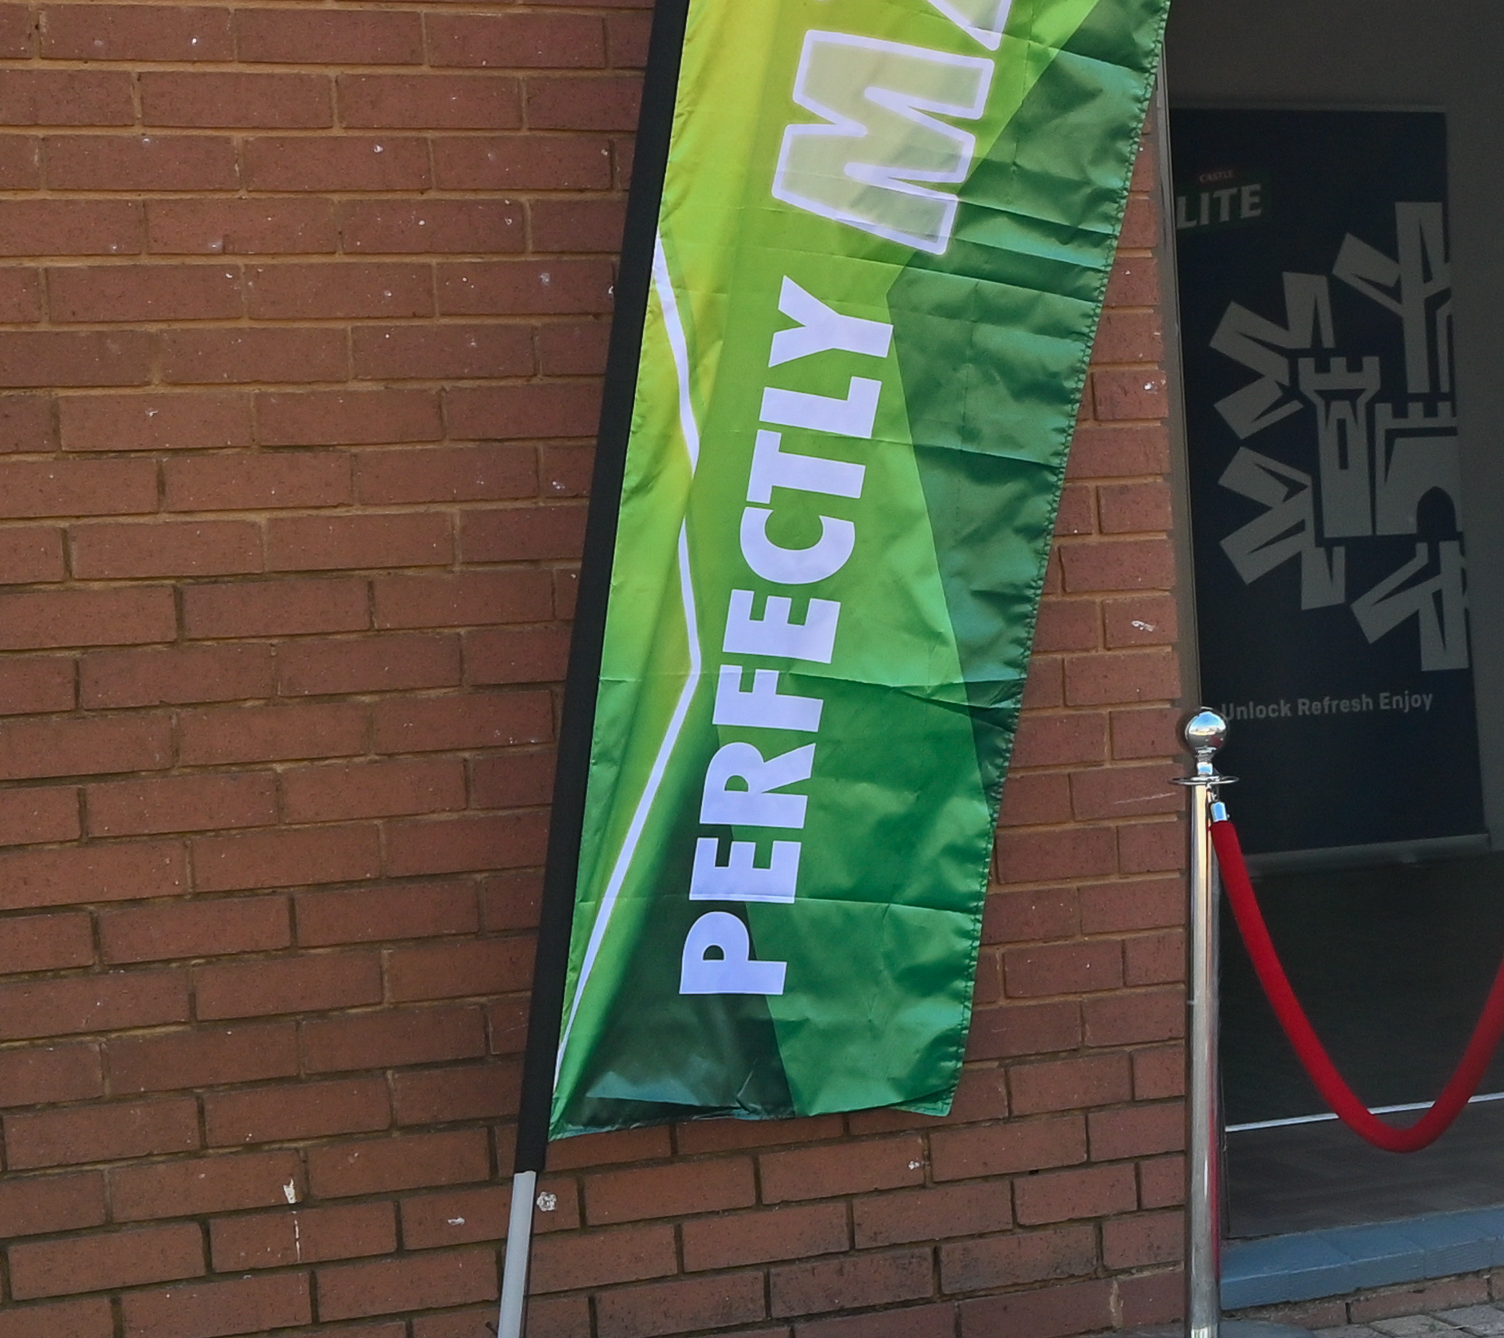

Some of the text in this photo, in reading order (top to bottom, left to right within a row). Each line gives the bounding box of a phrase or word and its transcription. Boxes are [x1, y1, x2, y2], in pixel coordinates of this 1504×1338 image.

[1176, 184, 1262, 230] LITE
[679, 274, 895, 996] PERFECTLY
[1221, 690, 1433, 721] Unlock Refresh Enjoy
